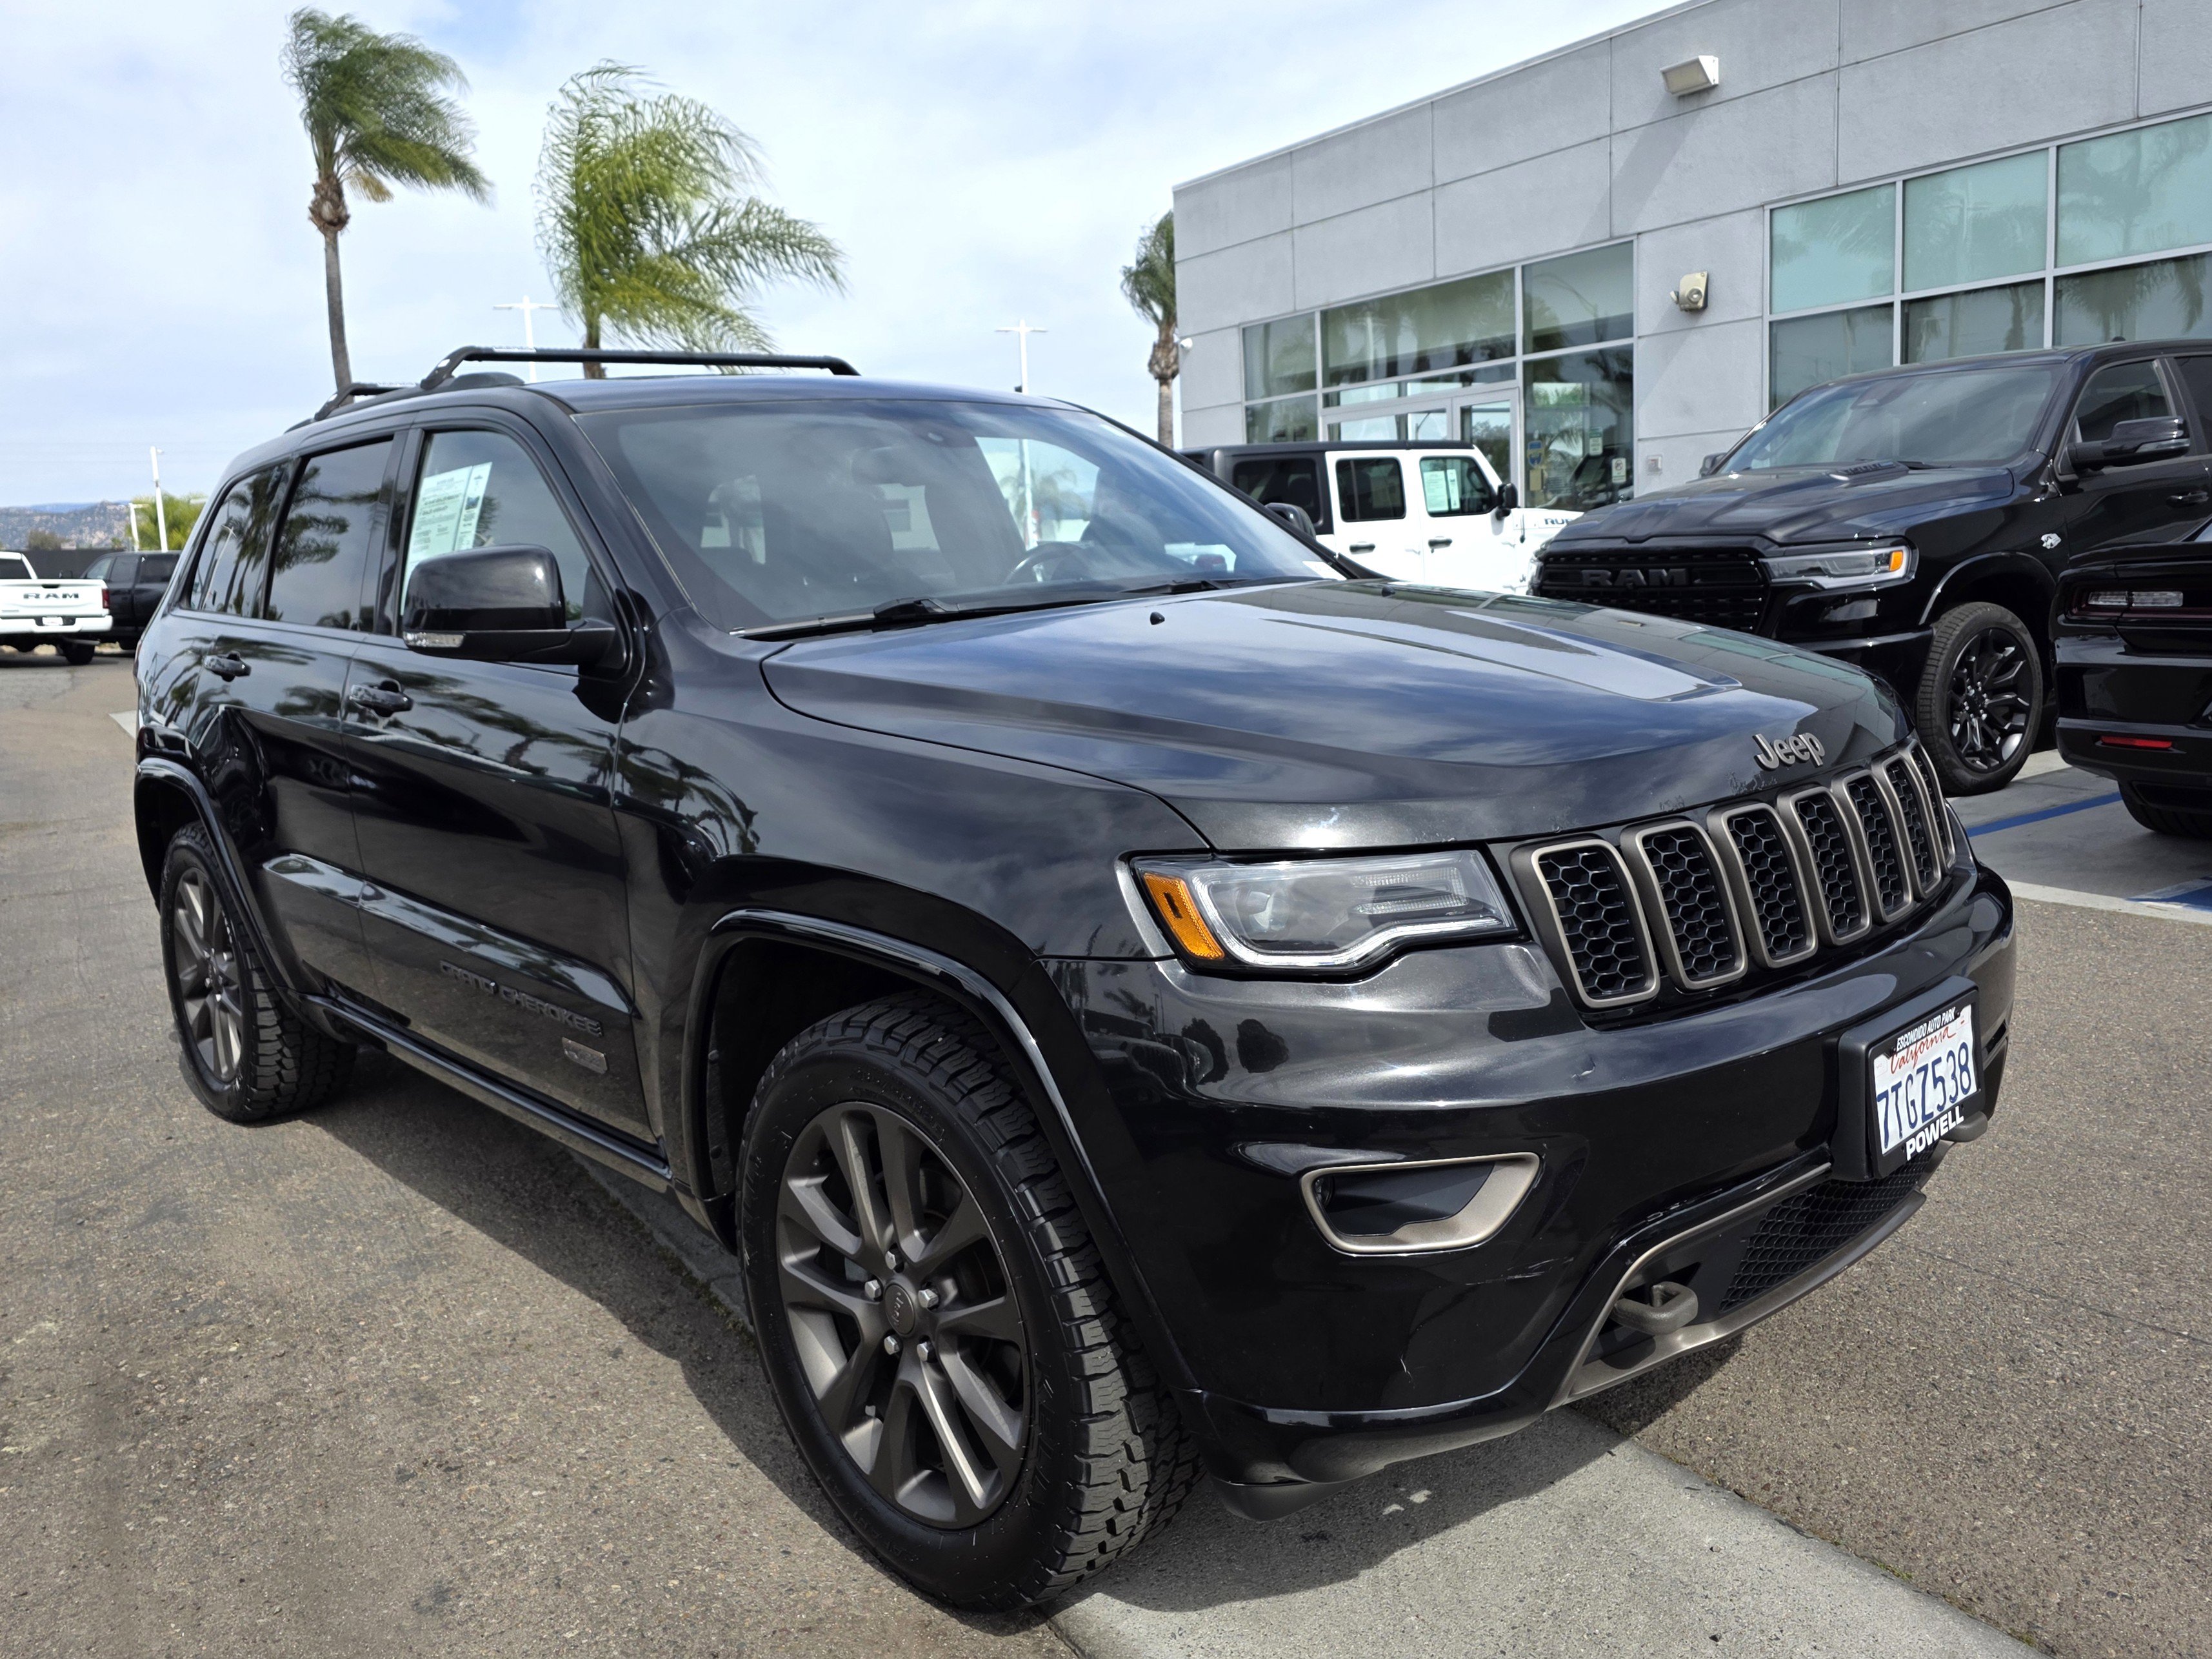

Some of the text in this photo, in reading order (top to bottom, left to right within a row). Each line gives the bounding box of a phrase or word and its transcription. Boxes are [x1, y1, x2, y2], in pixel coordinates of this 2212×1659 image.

[1580, 568, 1690, 587] RAM
[1752, 732, 1826, 772] Jeep
[499, 985, 604, 1037] CHEROKEE
[1895, 1007, 1956, 1052] ESCONDIDO AUTO PARK
[1890, 1026, 1957, 1074] California
[1876, 1041, 1972, 1149] 7TGZ538
[1906, 1105, 1964, 1161] POWELL
